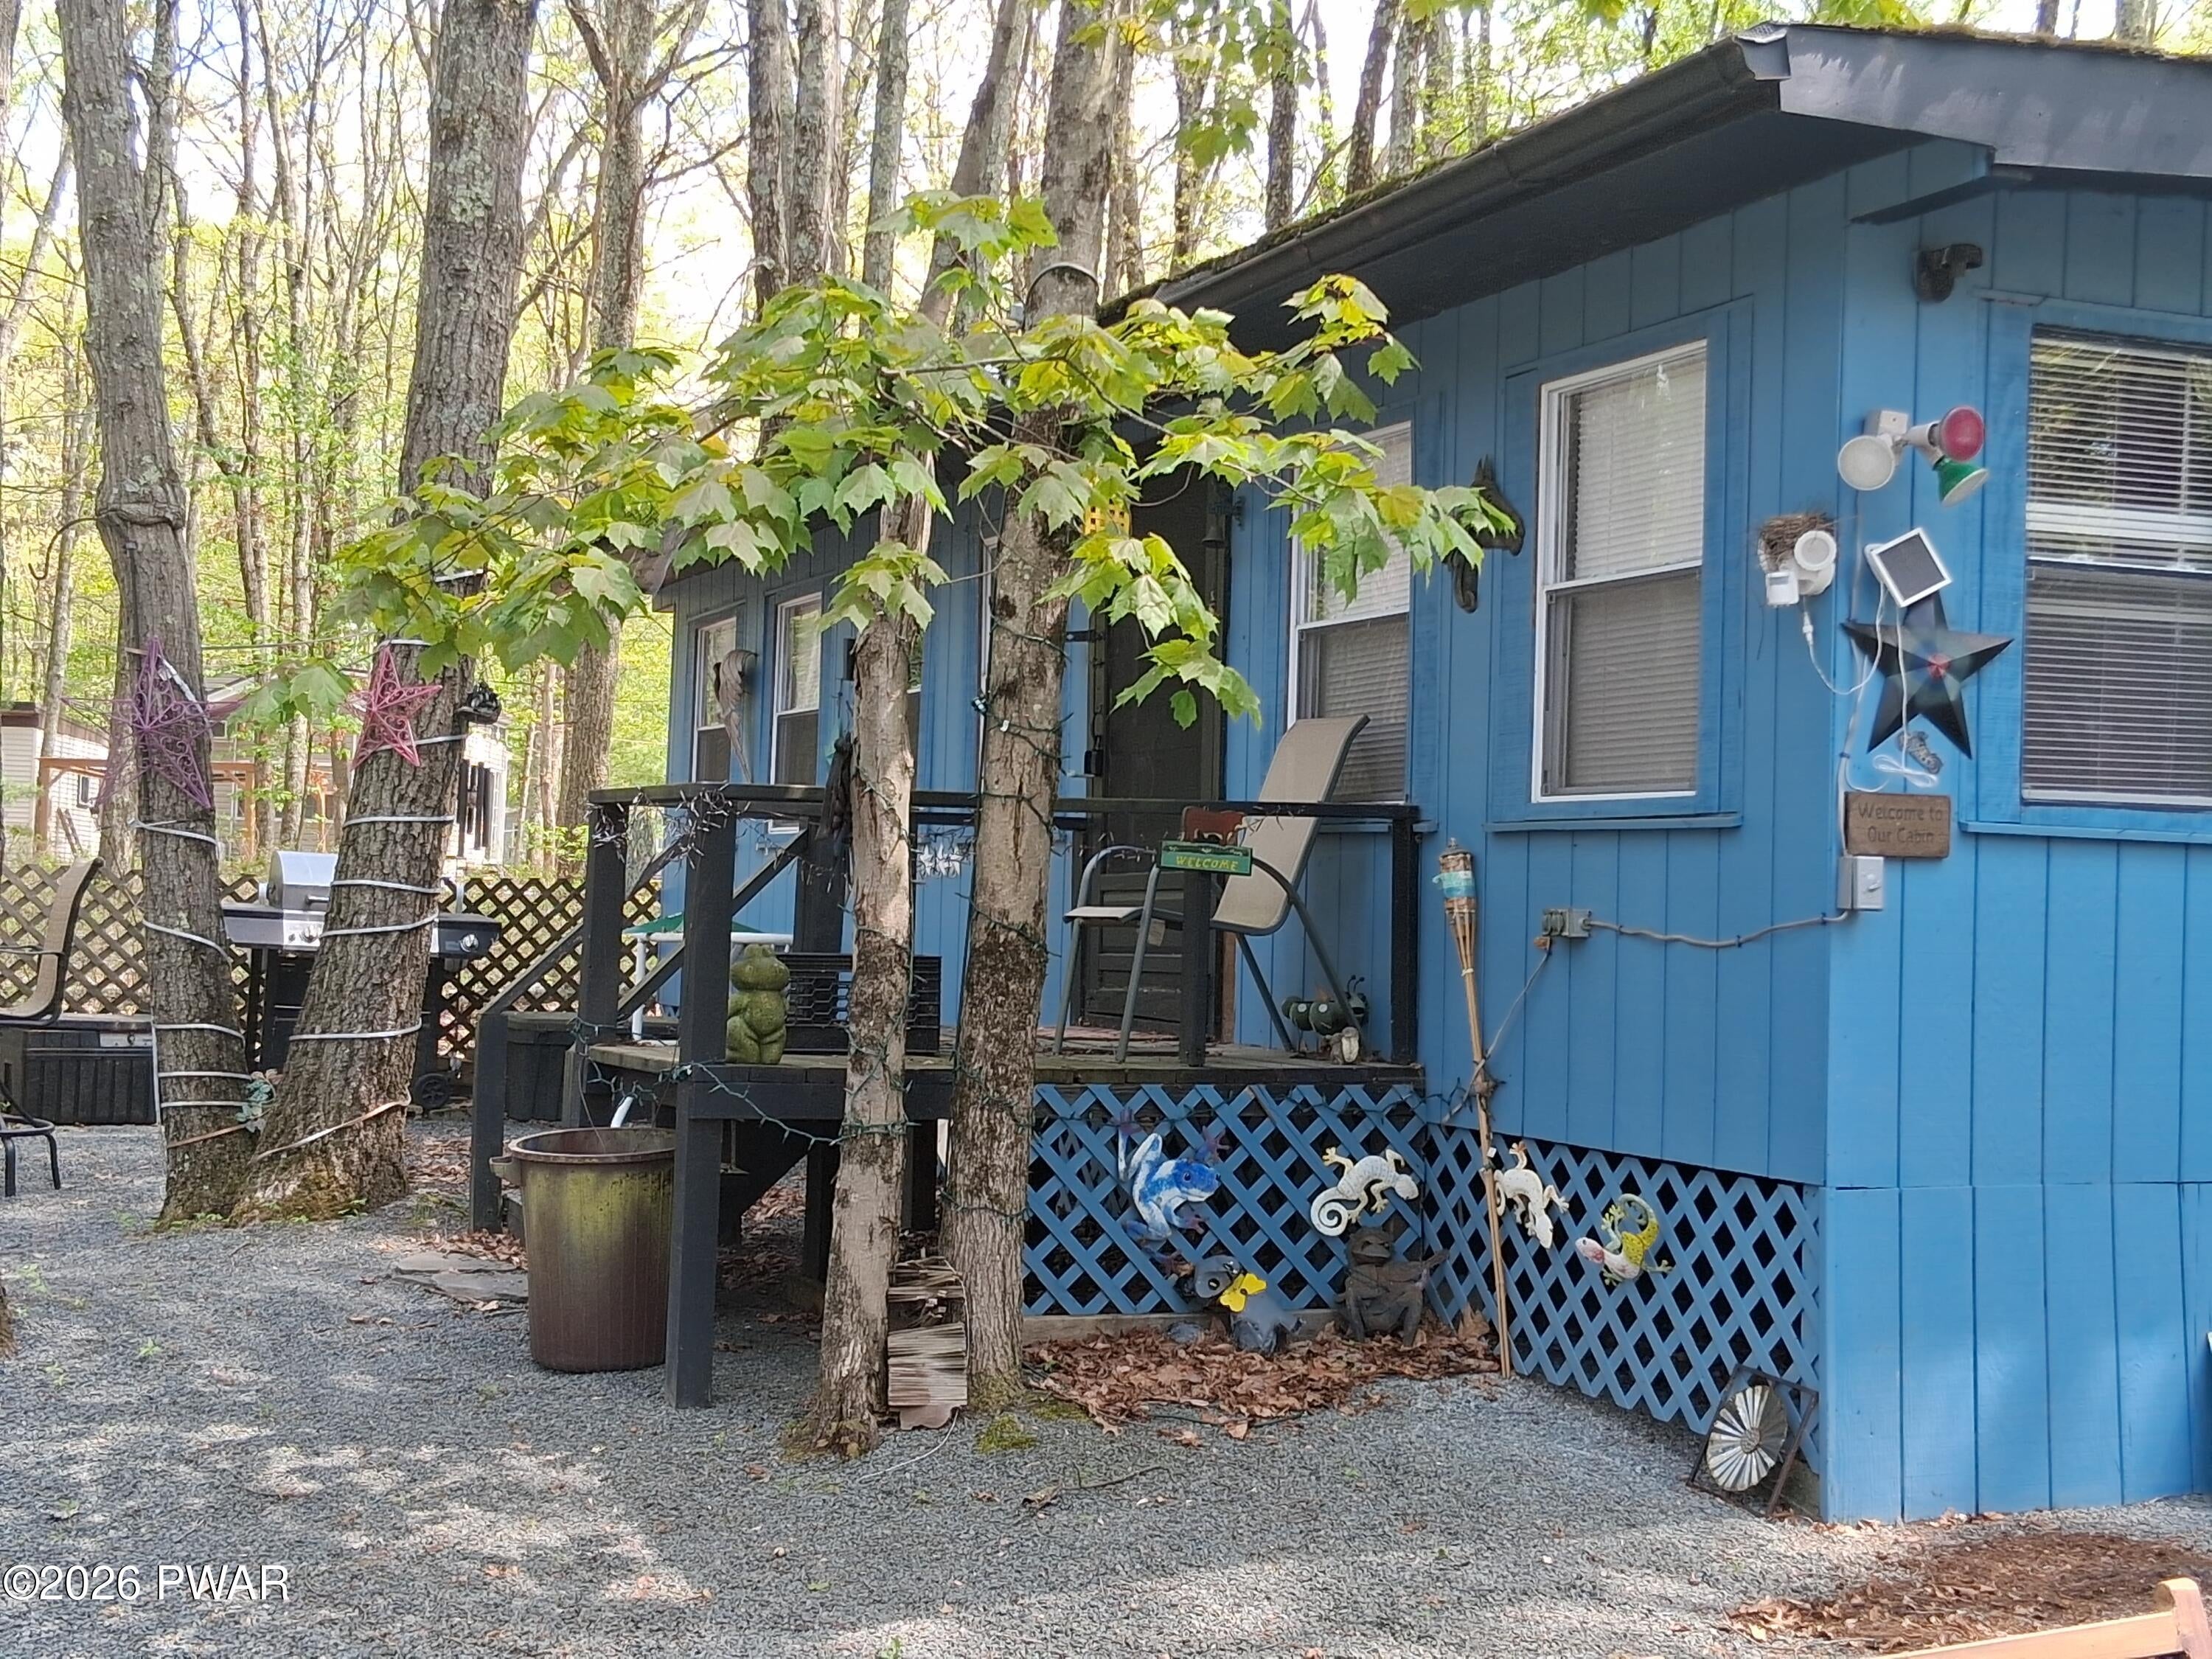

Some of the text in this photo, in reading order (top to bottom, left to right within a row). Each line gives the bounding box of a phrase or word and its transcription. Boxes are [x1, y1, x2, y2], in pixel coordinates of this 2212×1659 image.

[1858, 801, 1943, 821] Welcome to
[1868, 825, 1935, 843] Our Cabin
[1176, 855, 1239, 871] WELCOME
